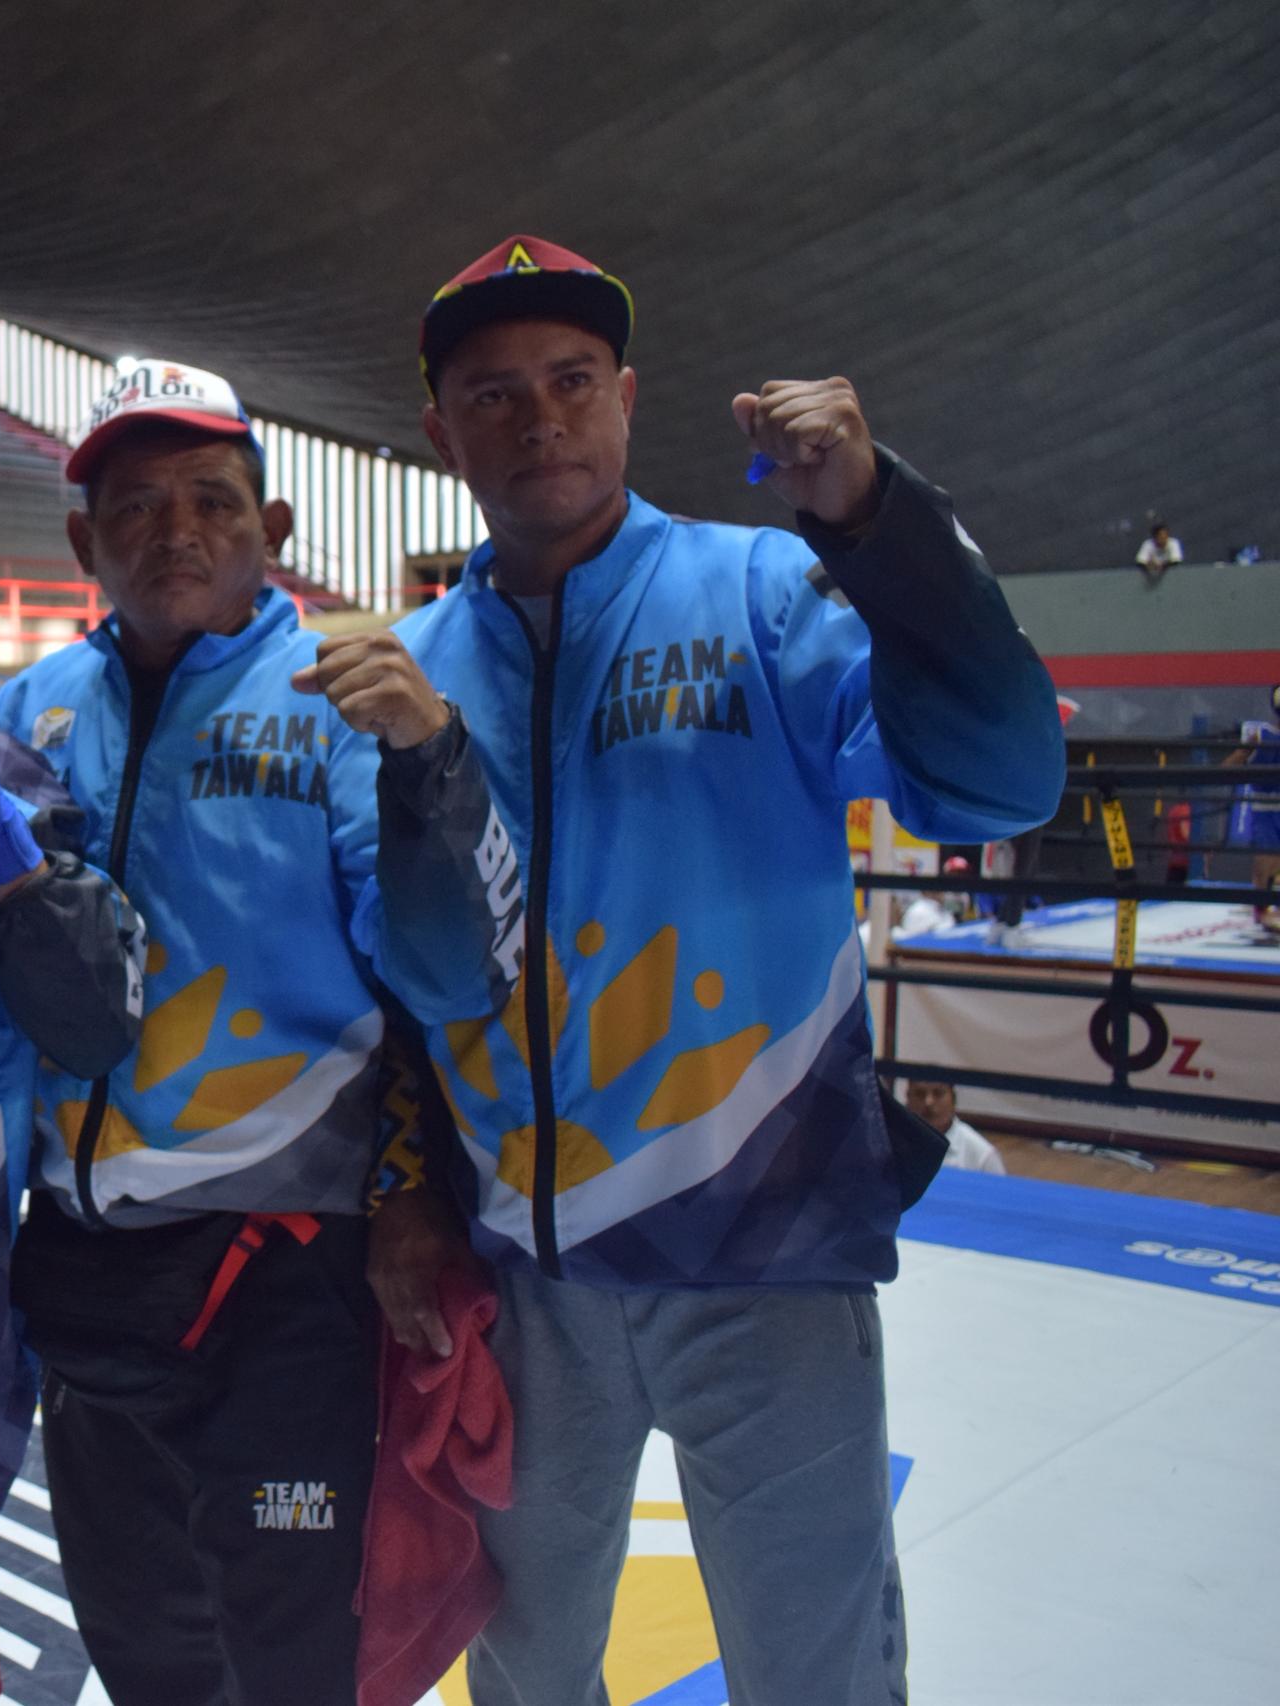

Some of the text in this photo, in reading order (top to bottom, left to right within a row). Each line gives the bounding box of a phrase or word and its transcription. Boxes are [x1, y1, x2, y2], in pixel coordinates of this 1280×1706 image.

[610, 635, 725, 700] TEAM
[212, 711, 316, 756] TEAM
[592, 682, 753, 756] TAWALA
[191, 752, 332, 808] TAWALA
[253, 1503, 335, 1530] TAWALA
[262, 1481, 326, 1505] TEAM
